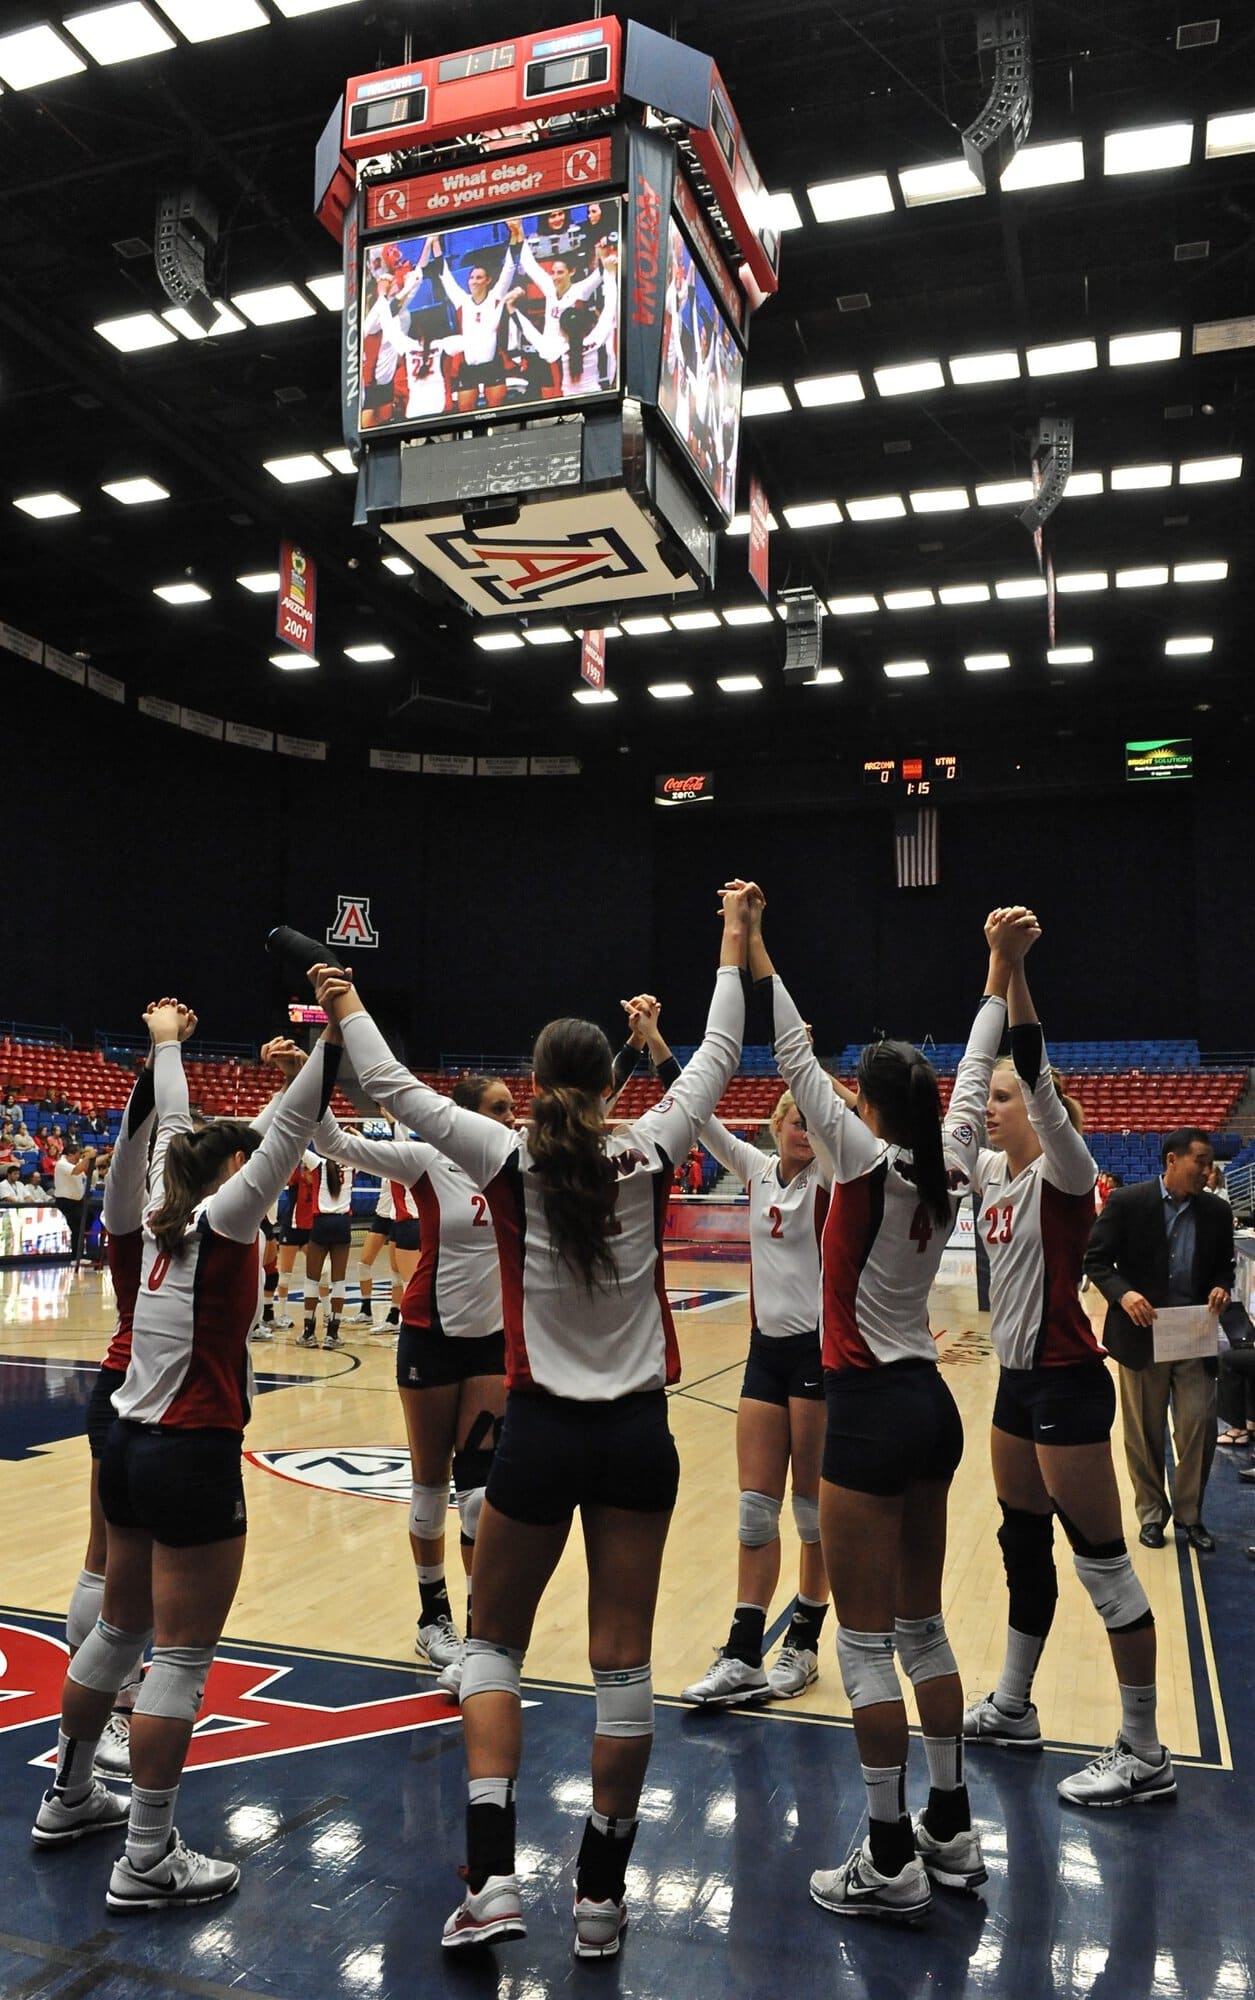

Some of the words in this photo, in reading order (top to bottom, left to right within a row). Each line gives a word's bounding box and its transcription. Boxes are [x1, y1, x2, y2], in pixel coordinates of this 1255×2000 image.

[465, 44, 515, 77] 1:15
[426, 195, 450, 210] do
[453, 187, 485, 208] you
[488, 171, 543, 197] need?
[442, 169, 487, 192] What
[491, 163, 528, 182] else
[425, 527, 648, 606] A
[281, 596, 313, 625] ARIZONA
[284, 616, 308, 643] 2001
[864, 760, 895, 771] ARIZONA
[935, 756, 956, 767] UTAH
[880, 770, 889, 784] 0
[946, 766, 956, 779] 0
[907, 781, 930, 796] 1:15
[326, 895, 379, 948] A
[768, 1205, 785, 1239] 2
[909, 1202, 934, 1254] 4
[984, 1204, 1014, 1245] 23
